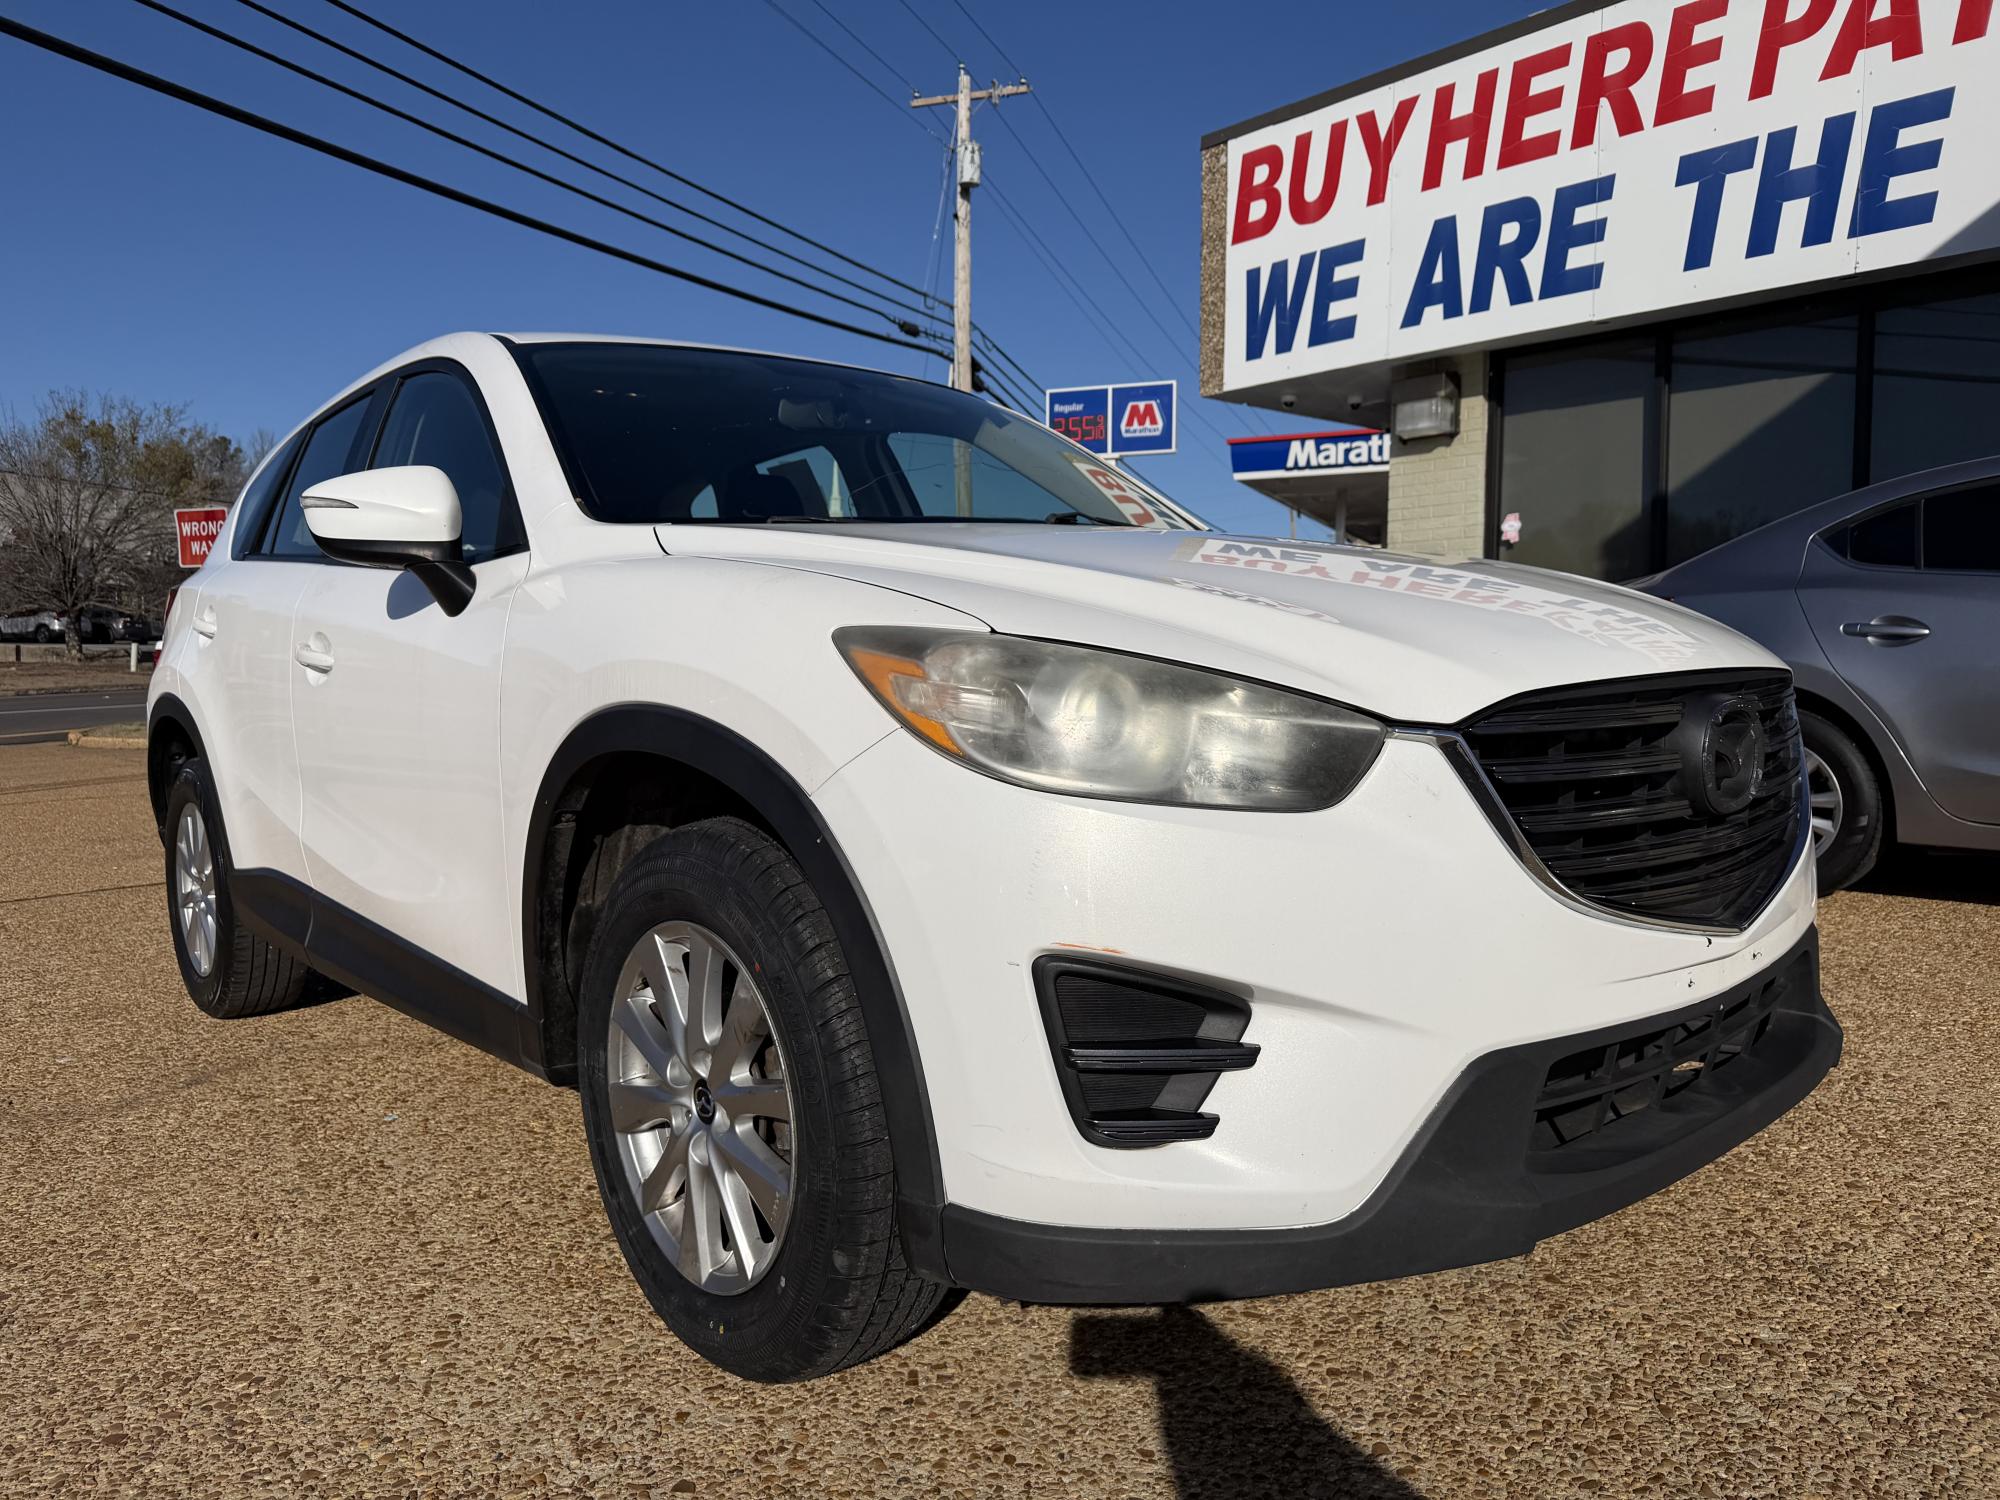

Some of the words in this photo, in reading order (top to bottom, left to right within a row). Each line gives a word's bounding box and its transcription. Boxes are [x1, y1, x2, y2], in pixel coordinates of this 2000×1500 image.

[1231, 94, 1421, 246] BUY
[1421, 0, 1730, 193] HERE
[1246, 238, 1366, 362] WE
[1400, 173, 1617, 329] ARE
[1674, 86, 1956, 272] THE
[1053, 403, 1085, 414] Regular
[1125, 403, 1159, 427] M
